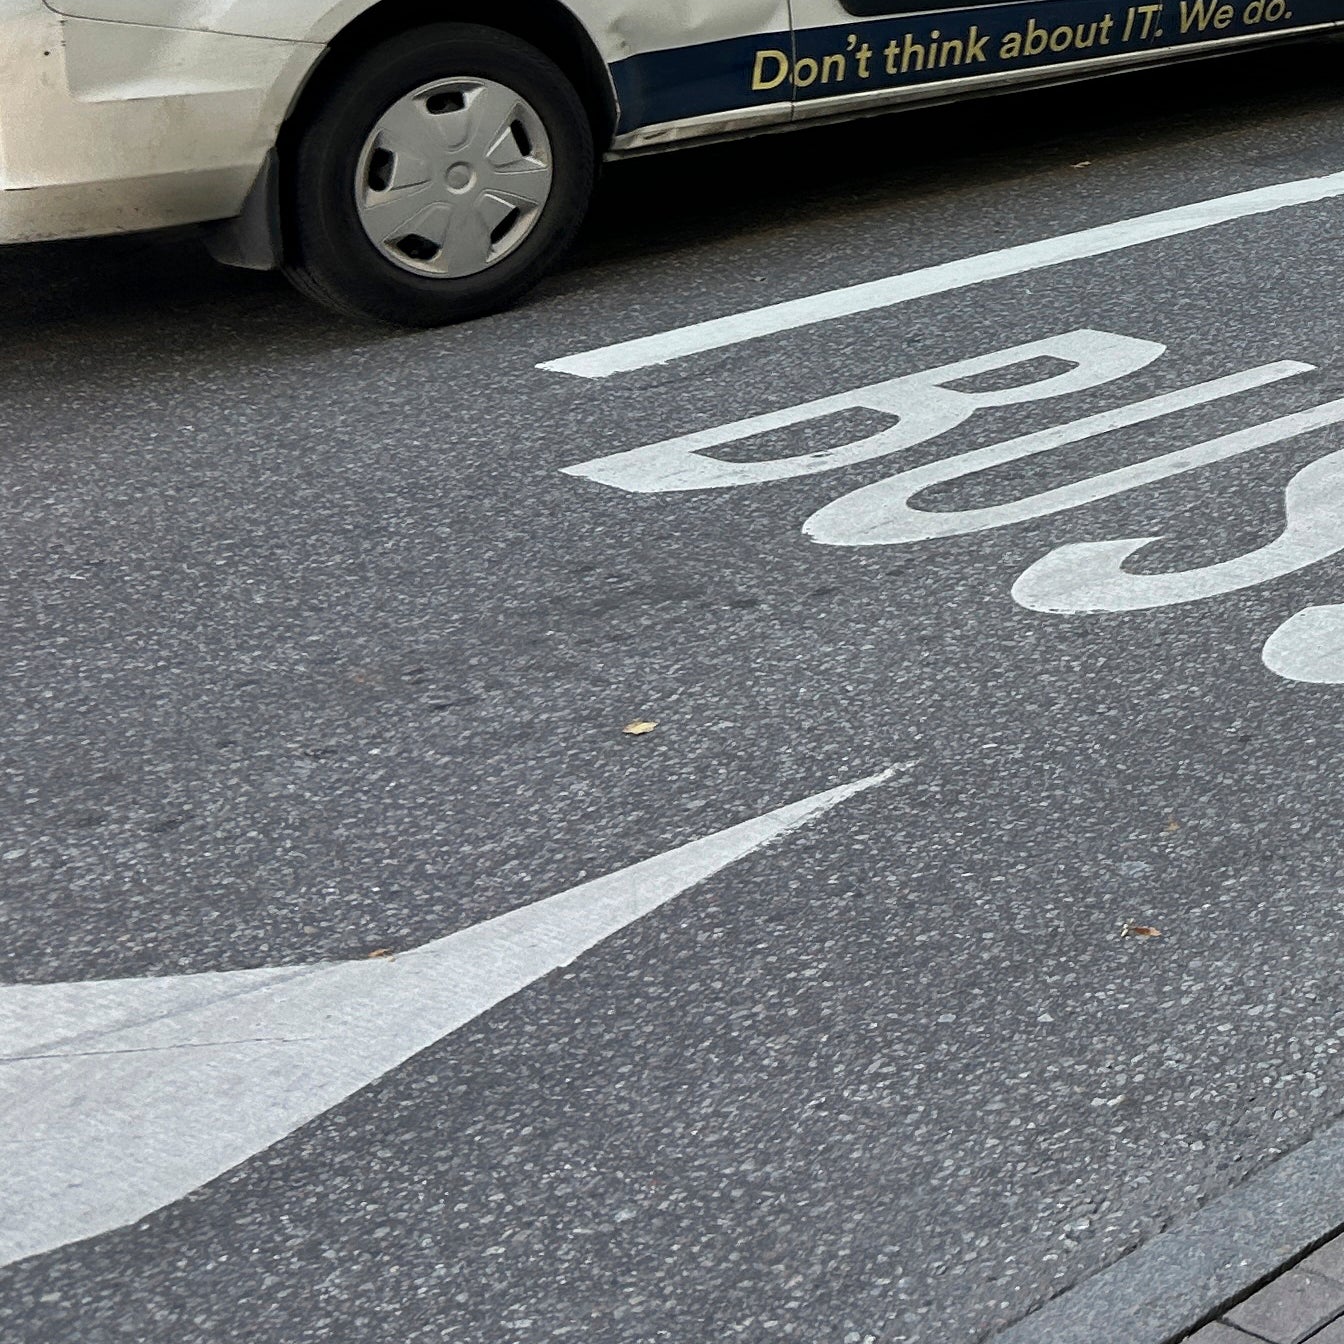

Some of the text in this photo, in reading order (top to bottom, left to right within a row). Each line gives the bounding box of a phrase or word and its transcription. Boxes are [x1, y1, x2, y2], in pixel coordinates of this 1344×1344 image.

[752, 34, 870, 90] Don't
[884, 25, 991, 75] think
[999, 18, 1114, 59] about
[1121, 4, 1165, 43] IT.
